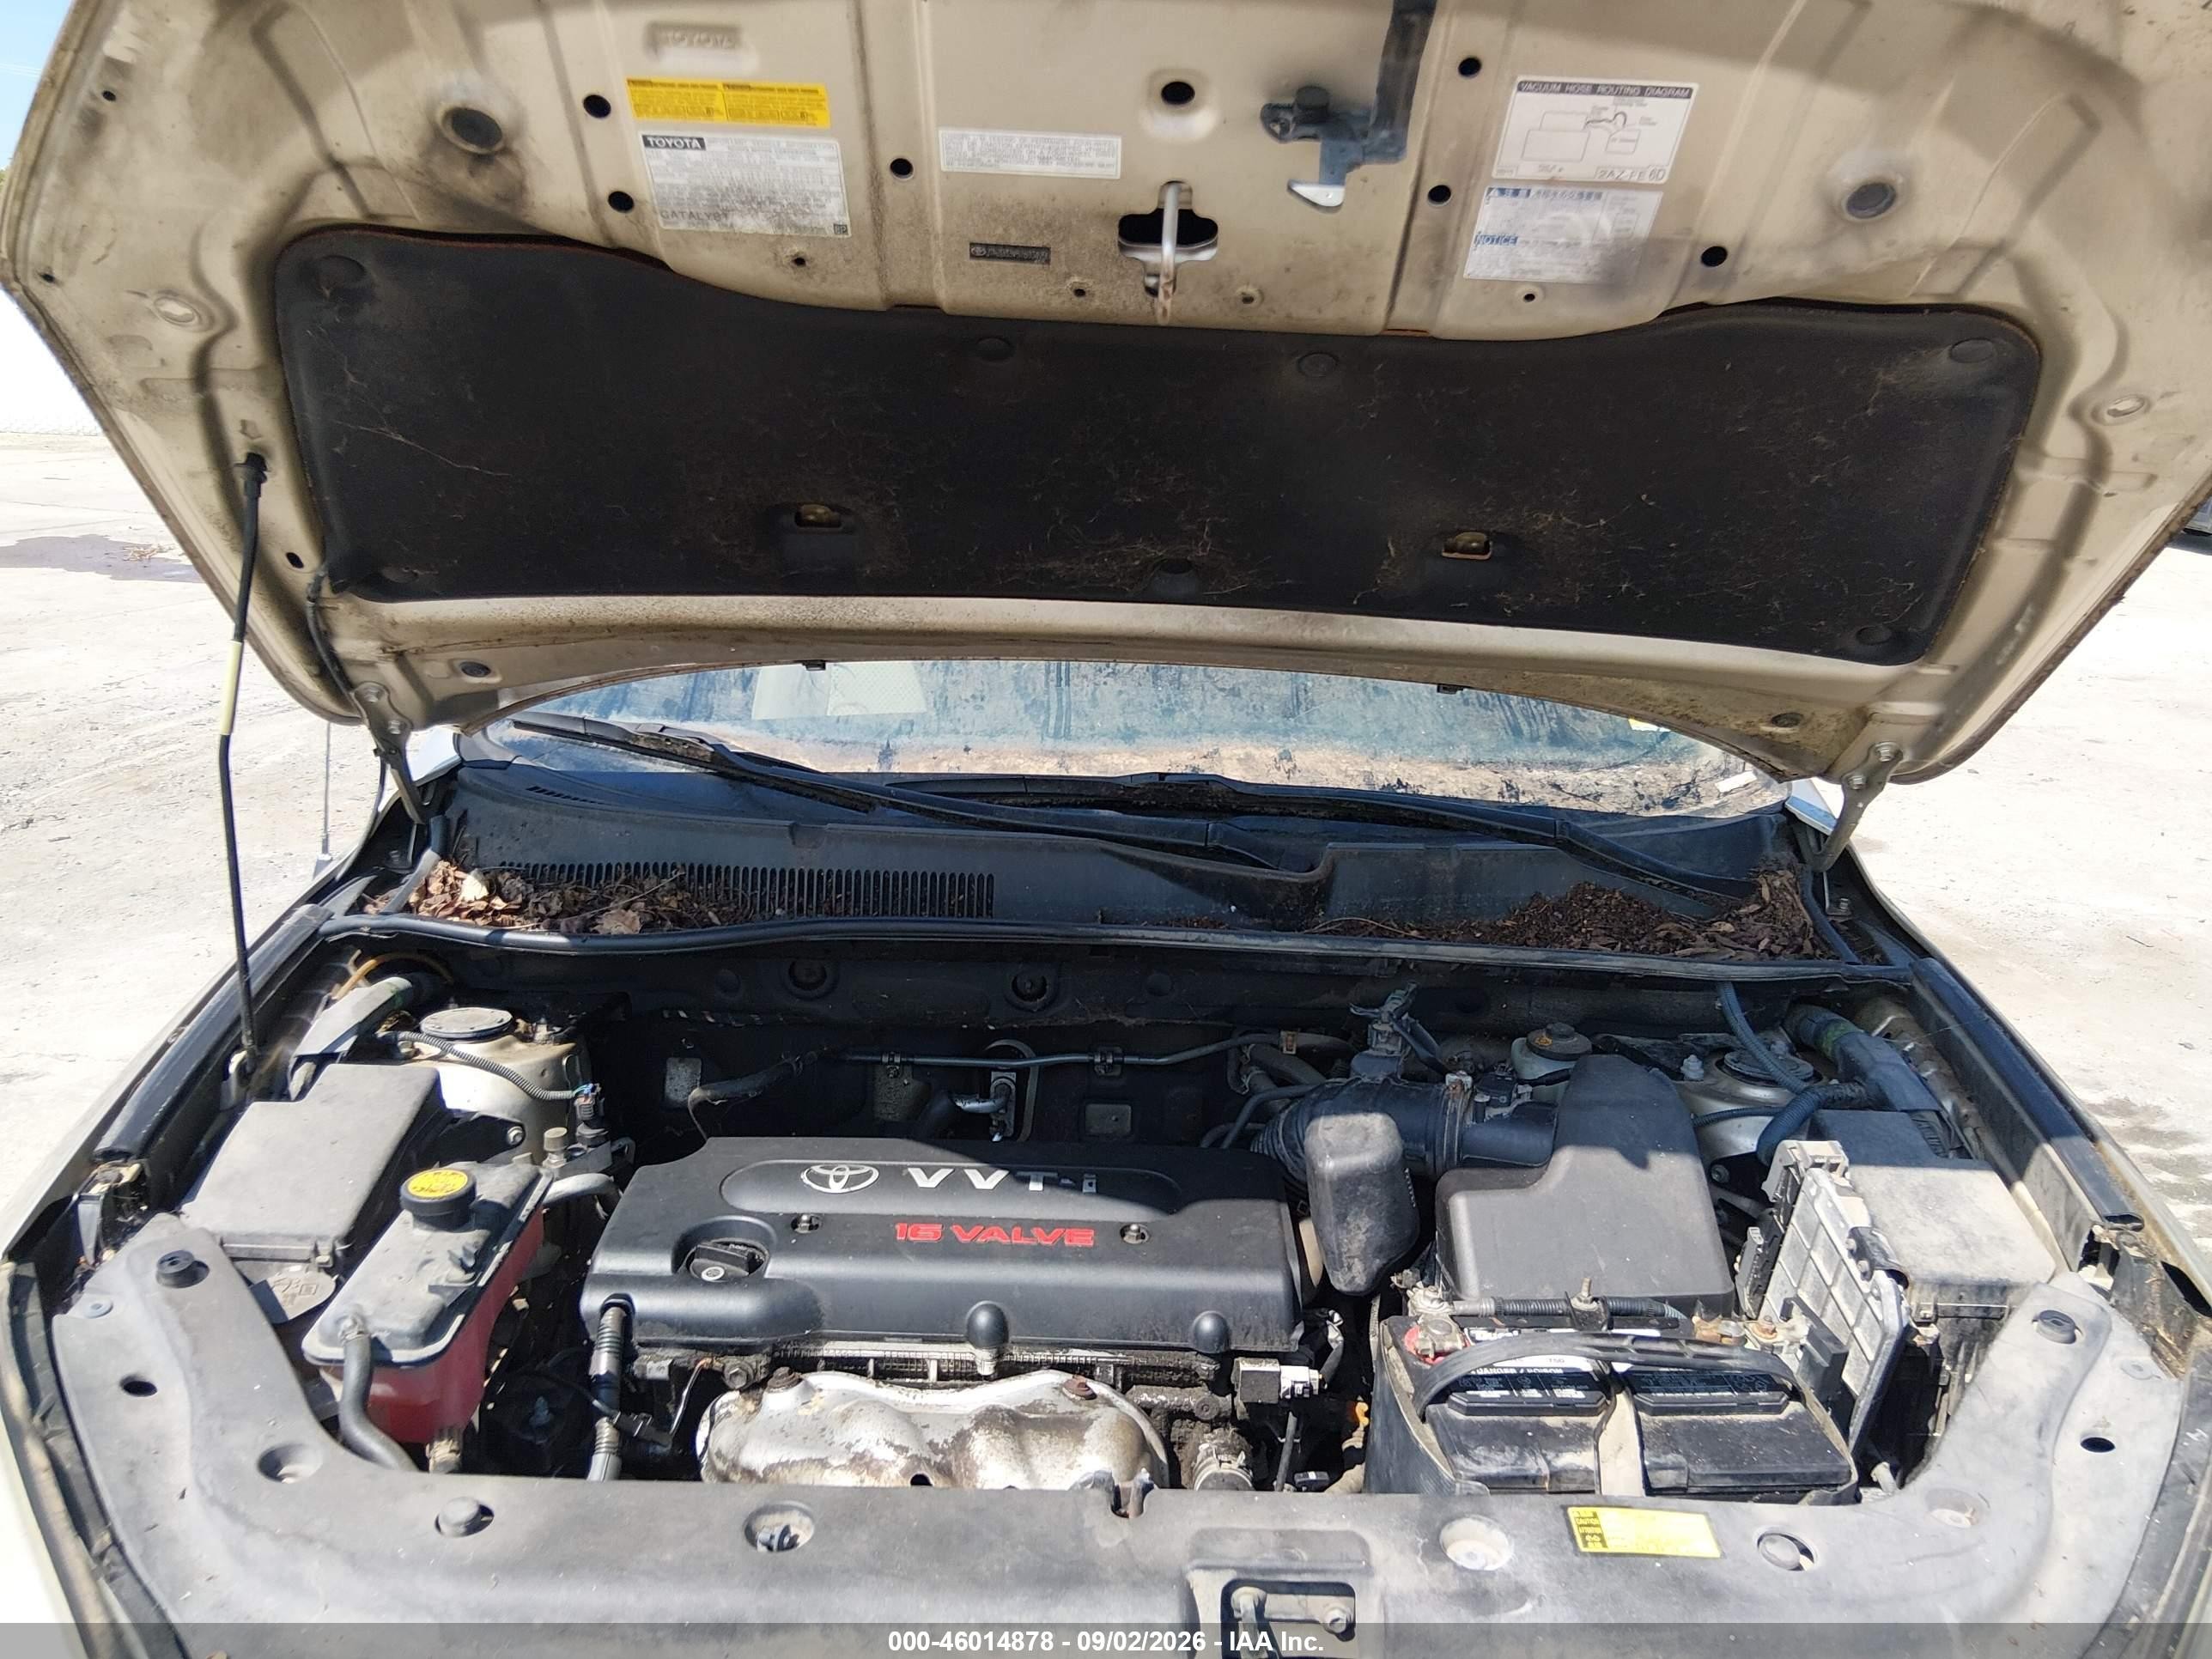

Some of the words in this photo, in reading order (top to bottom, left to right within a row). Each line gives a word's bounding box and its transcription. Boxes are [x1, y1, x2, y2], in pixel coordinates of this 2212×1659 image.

[1520, 82, 1561, 93] VACUUM
[1565, 83, 1593, 94] HOSE
[1595, 85, 1641, 95] ROUTING
[1644, 86, 1691, 97] DIAGRAM
[647, 137, 702, 149] TOYOTA
[1476, 234, 1517, 246] NOTICE
[895, 1223, 944, 1243] 16
[950, 1224, 1095, 1247] VALVE
